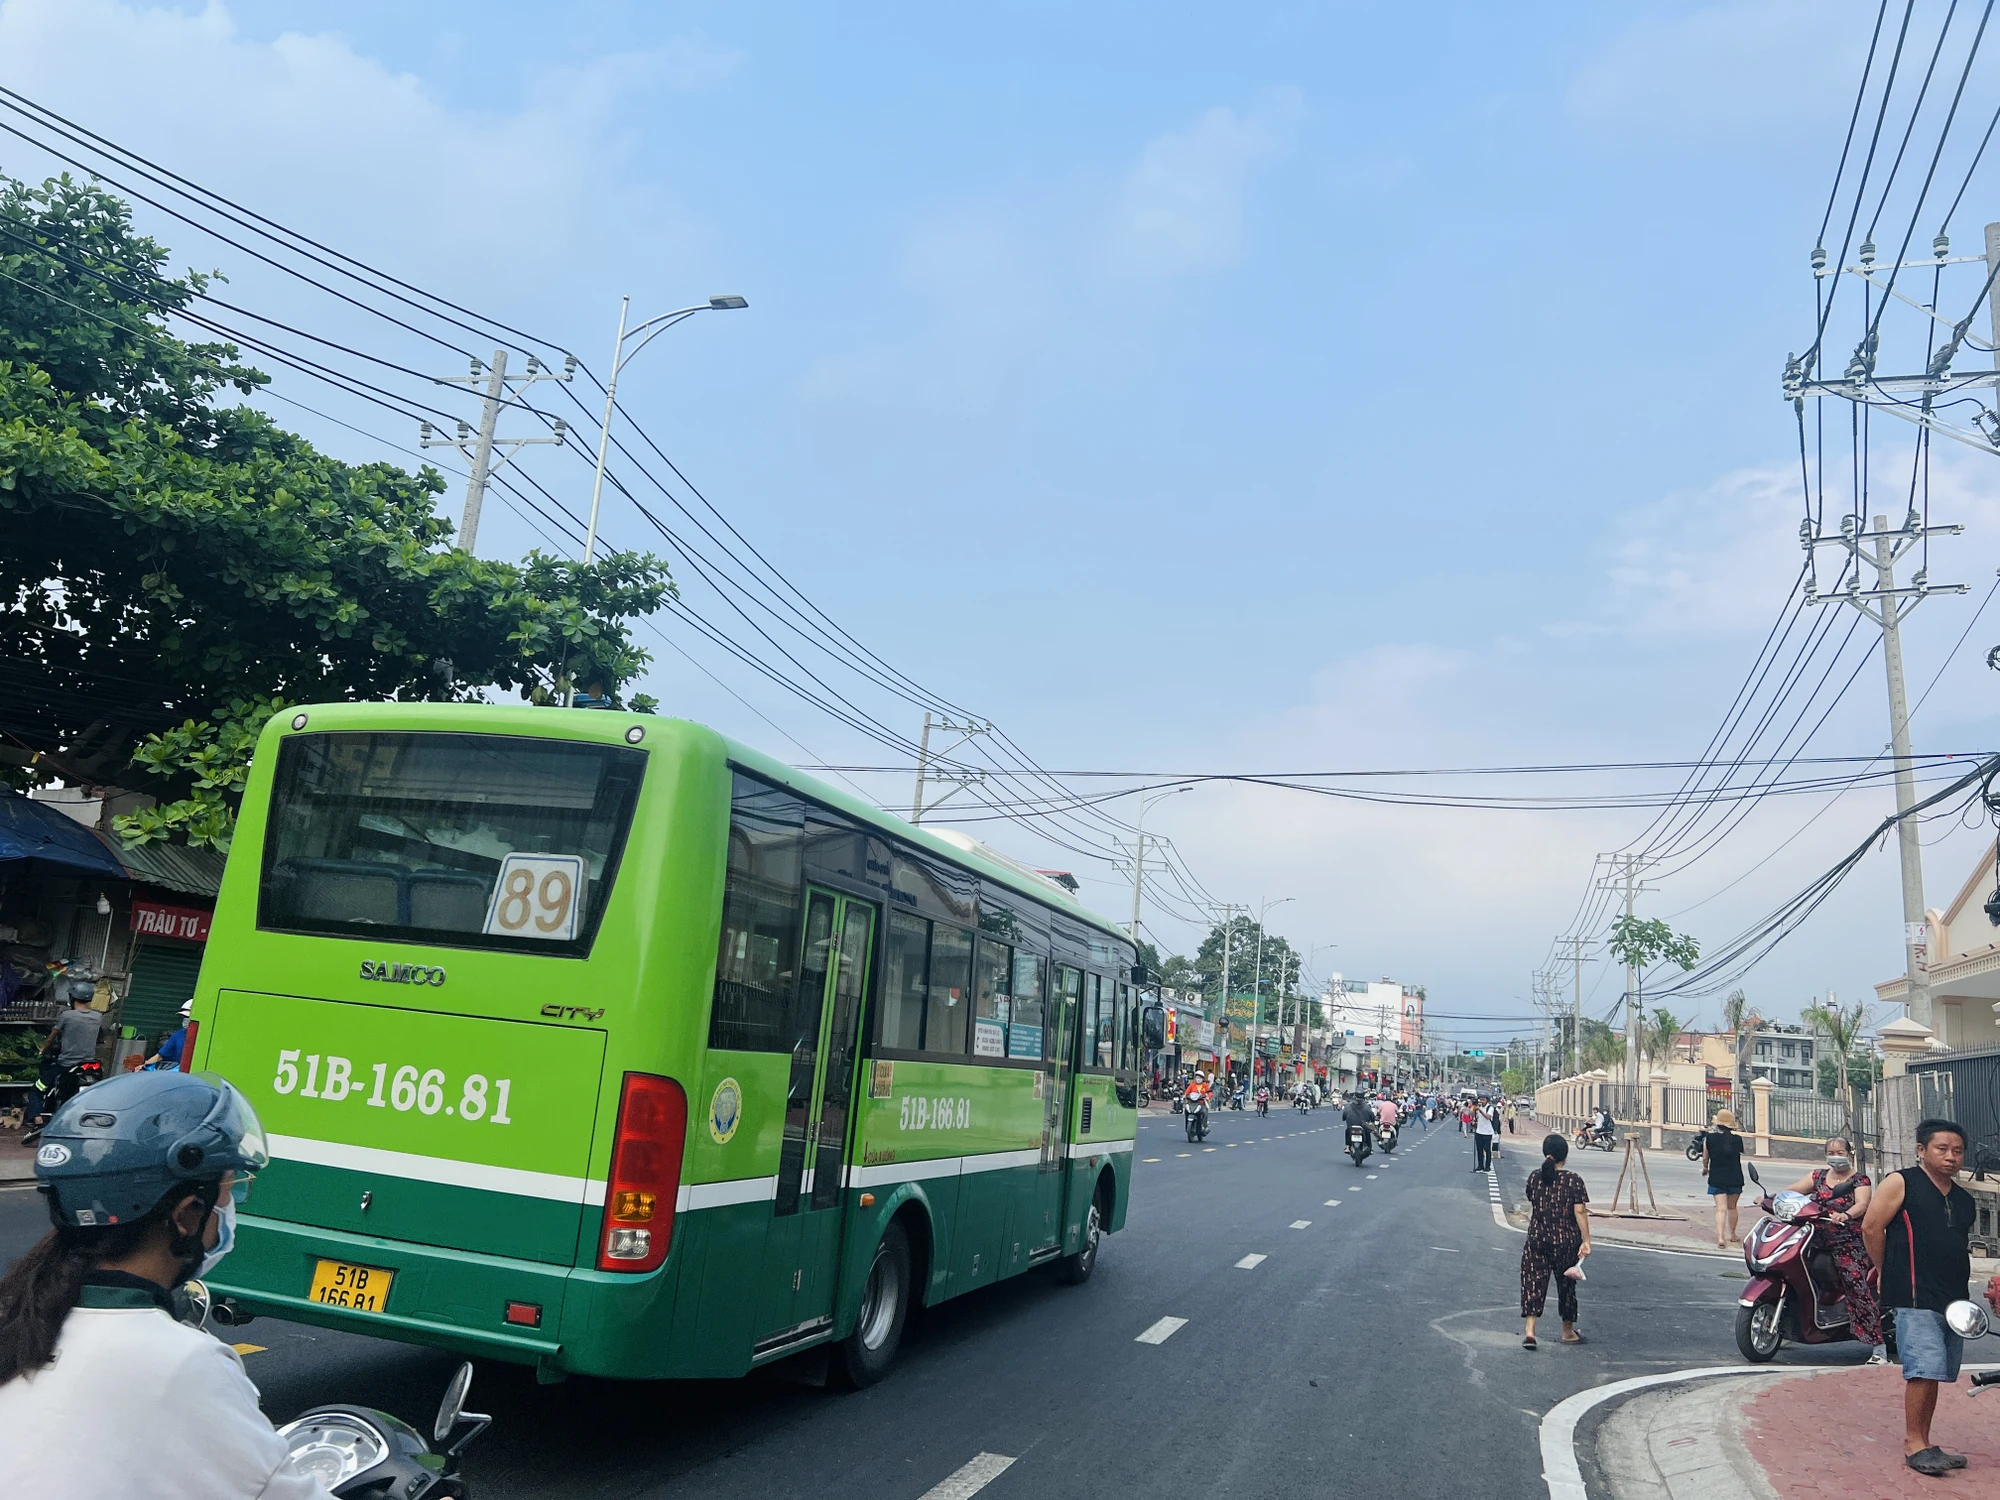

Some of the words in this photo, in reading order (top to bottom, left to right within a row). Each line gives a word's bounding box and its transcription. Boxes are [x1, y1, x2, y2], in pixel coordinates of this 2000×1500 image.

[497, 868, 572, 933] 89
[136, 908, 177, 935] TRÂU
[179, 916, 200, 938] TƠ
[359, 959, 447, 987] SAMCO
[540, 1003, 606, 1022] CITY
[273, 1049, 512, 1125] 51B-166.81
[899, 1095, 970, 1131] 51B-166.81
[334, 1266, 369, 1290] 51B
